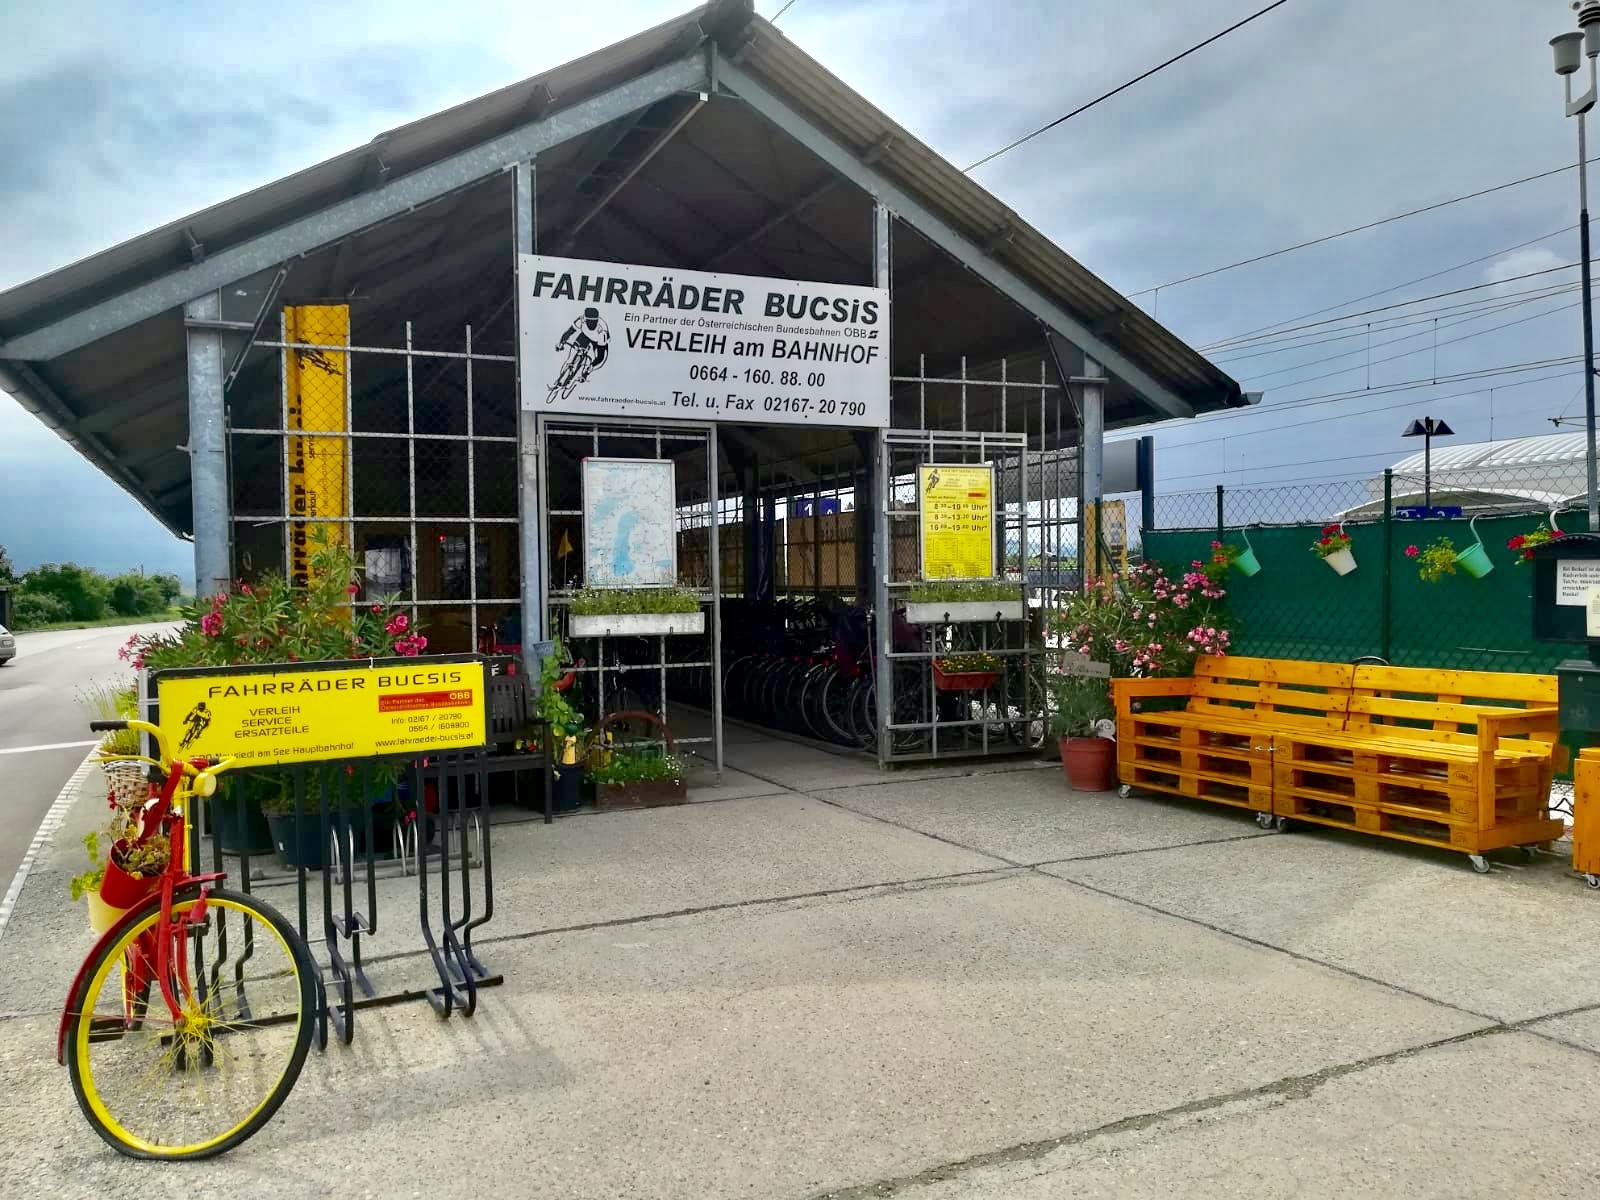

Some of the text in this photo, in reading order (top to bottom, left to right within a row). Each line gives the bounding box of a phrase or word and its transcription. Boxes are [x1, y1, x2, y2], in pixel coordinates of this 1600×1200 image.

[533, 270, 744, 314] FAHRRÄDER
[624, 312, 867, 338] Ein Partner der Österreichischen Bundesbahnen ÖBB
[625, 328, 878, 364] VERLEIH am BAHNHOF
[690, 365, 728, 382] 0664
[808, 372, 825, 388] 00
[578, 394, 666, 406] www.fahrraeder-bucsis.at
[672, 391, 699, 408] Tel.
[706, 396, 720, 408] u.
[726, 394, 754, 411] Fax
[804, 504, 812, 516] 1
[209, 672, 462, 698] FAHRRÄDER BUCSIS
[249, 706, 300, 717] VERLEIH
[241, 716, 292, 728] SERVICE
[234, 726, 309, 738] ERSATZTEILE
[376, 732, 473, 747] www.fahrraeder-bucsis.at
[293, 742, 354, 755] Hauptbahnhof
